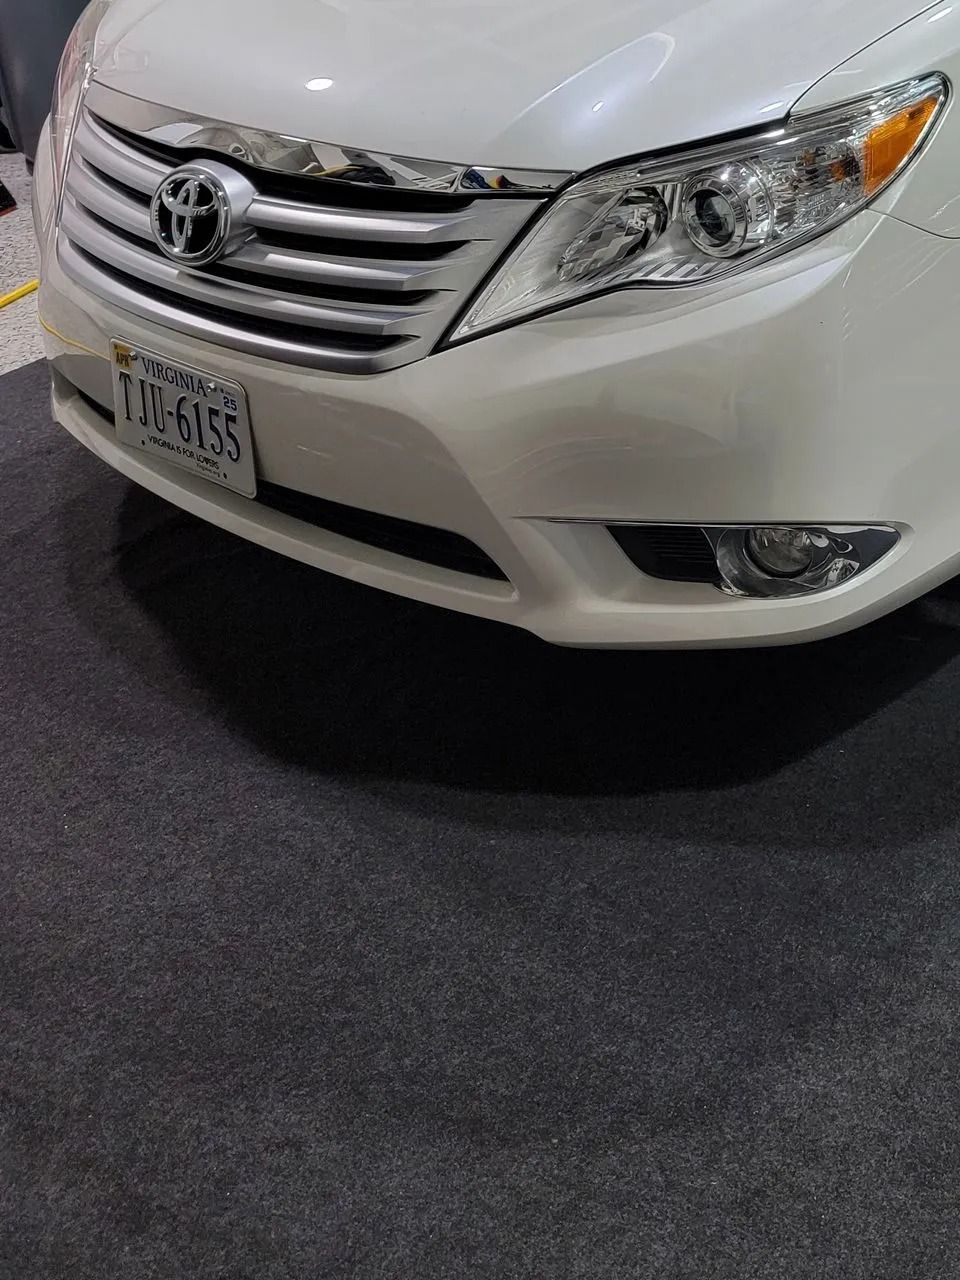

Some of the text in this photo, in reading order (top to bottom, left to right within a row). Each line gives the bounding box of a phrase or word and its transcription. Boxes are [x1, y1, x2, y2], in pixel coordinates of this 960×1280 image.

[116, 351, 208, 398] APR VIRGINIA
[118, 370, 241, 463] TJU-6155
[223, 395, 238, 412] 25
[147, 434, 176, 452] VIRGINIA
[176, 445, 182, 455] IS
[182, 447, 196, 460] FOR
